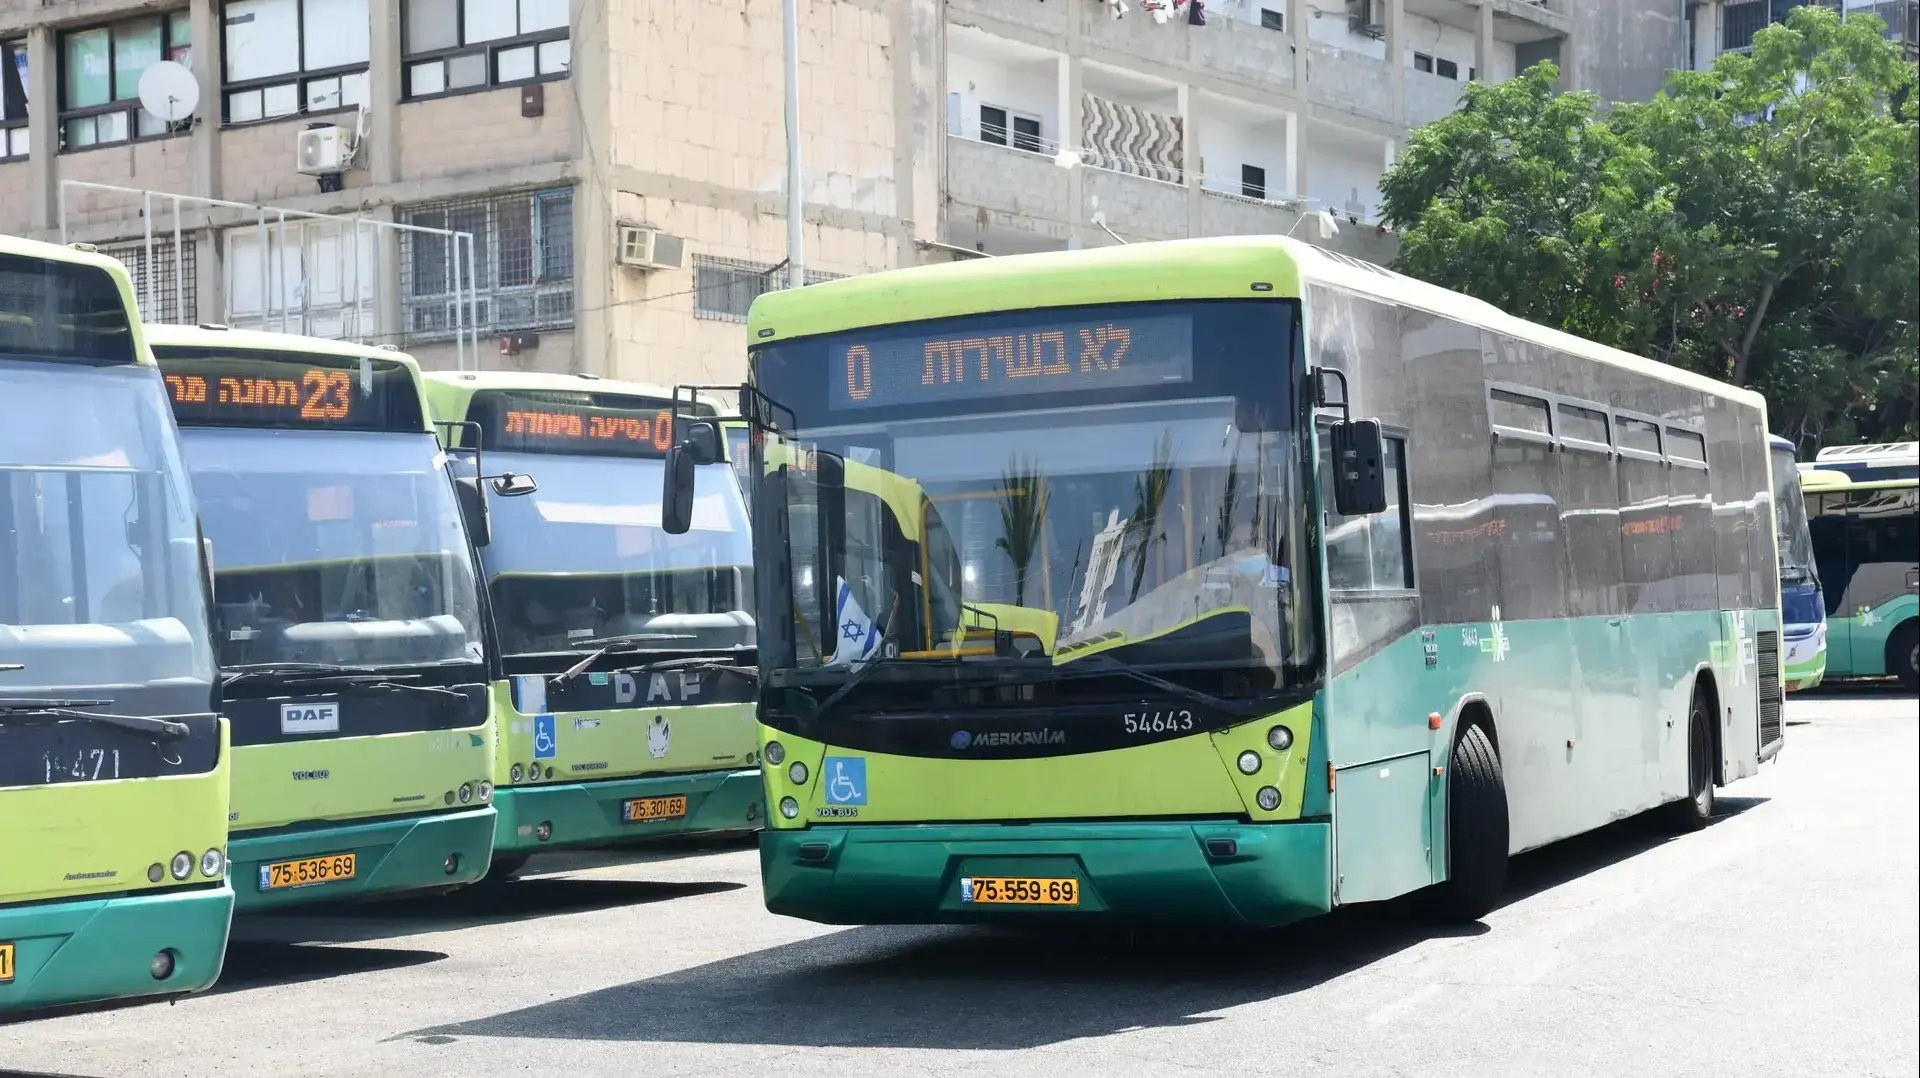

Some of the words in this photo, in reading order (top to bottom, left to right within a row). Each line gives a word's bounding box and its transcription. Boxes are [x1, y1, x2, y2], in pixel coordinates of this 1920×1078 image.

[922, 331, 1070, 385] בשירות
[1080, 324, 1130, 373] לא
[847, 345, 872, 400] 0
[219, 378, 298, 406] תחנה
[301, 370, 350, 418] 23
[589, 416, 650, 440] נסיעה
[654, 411, 673, 450] 0
[614, 672, 701, 704] DAF
[286, 708, 333, 721] DAF
[1124, 709, 1193, 734] 54643
[837, 807, 858, 817] BUS
